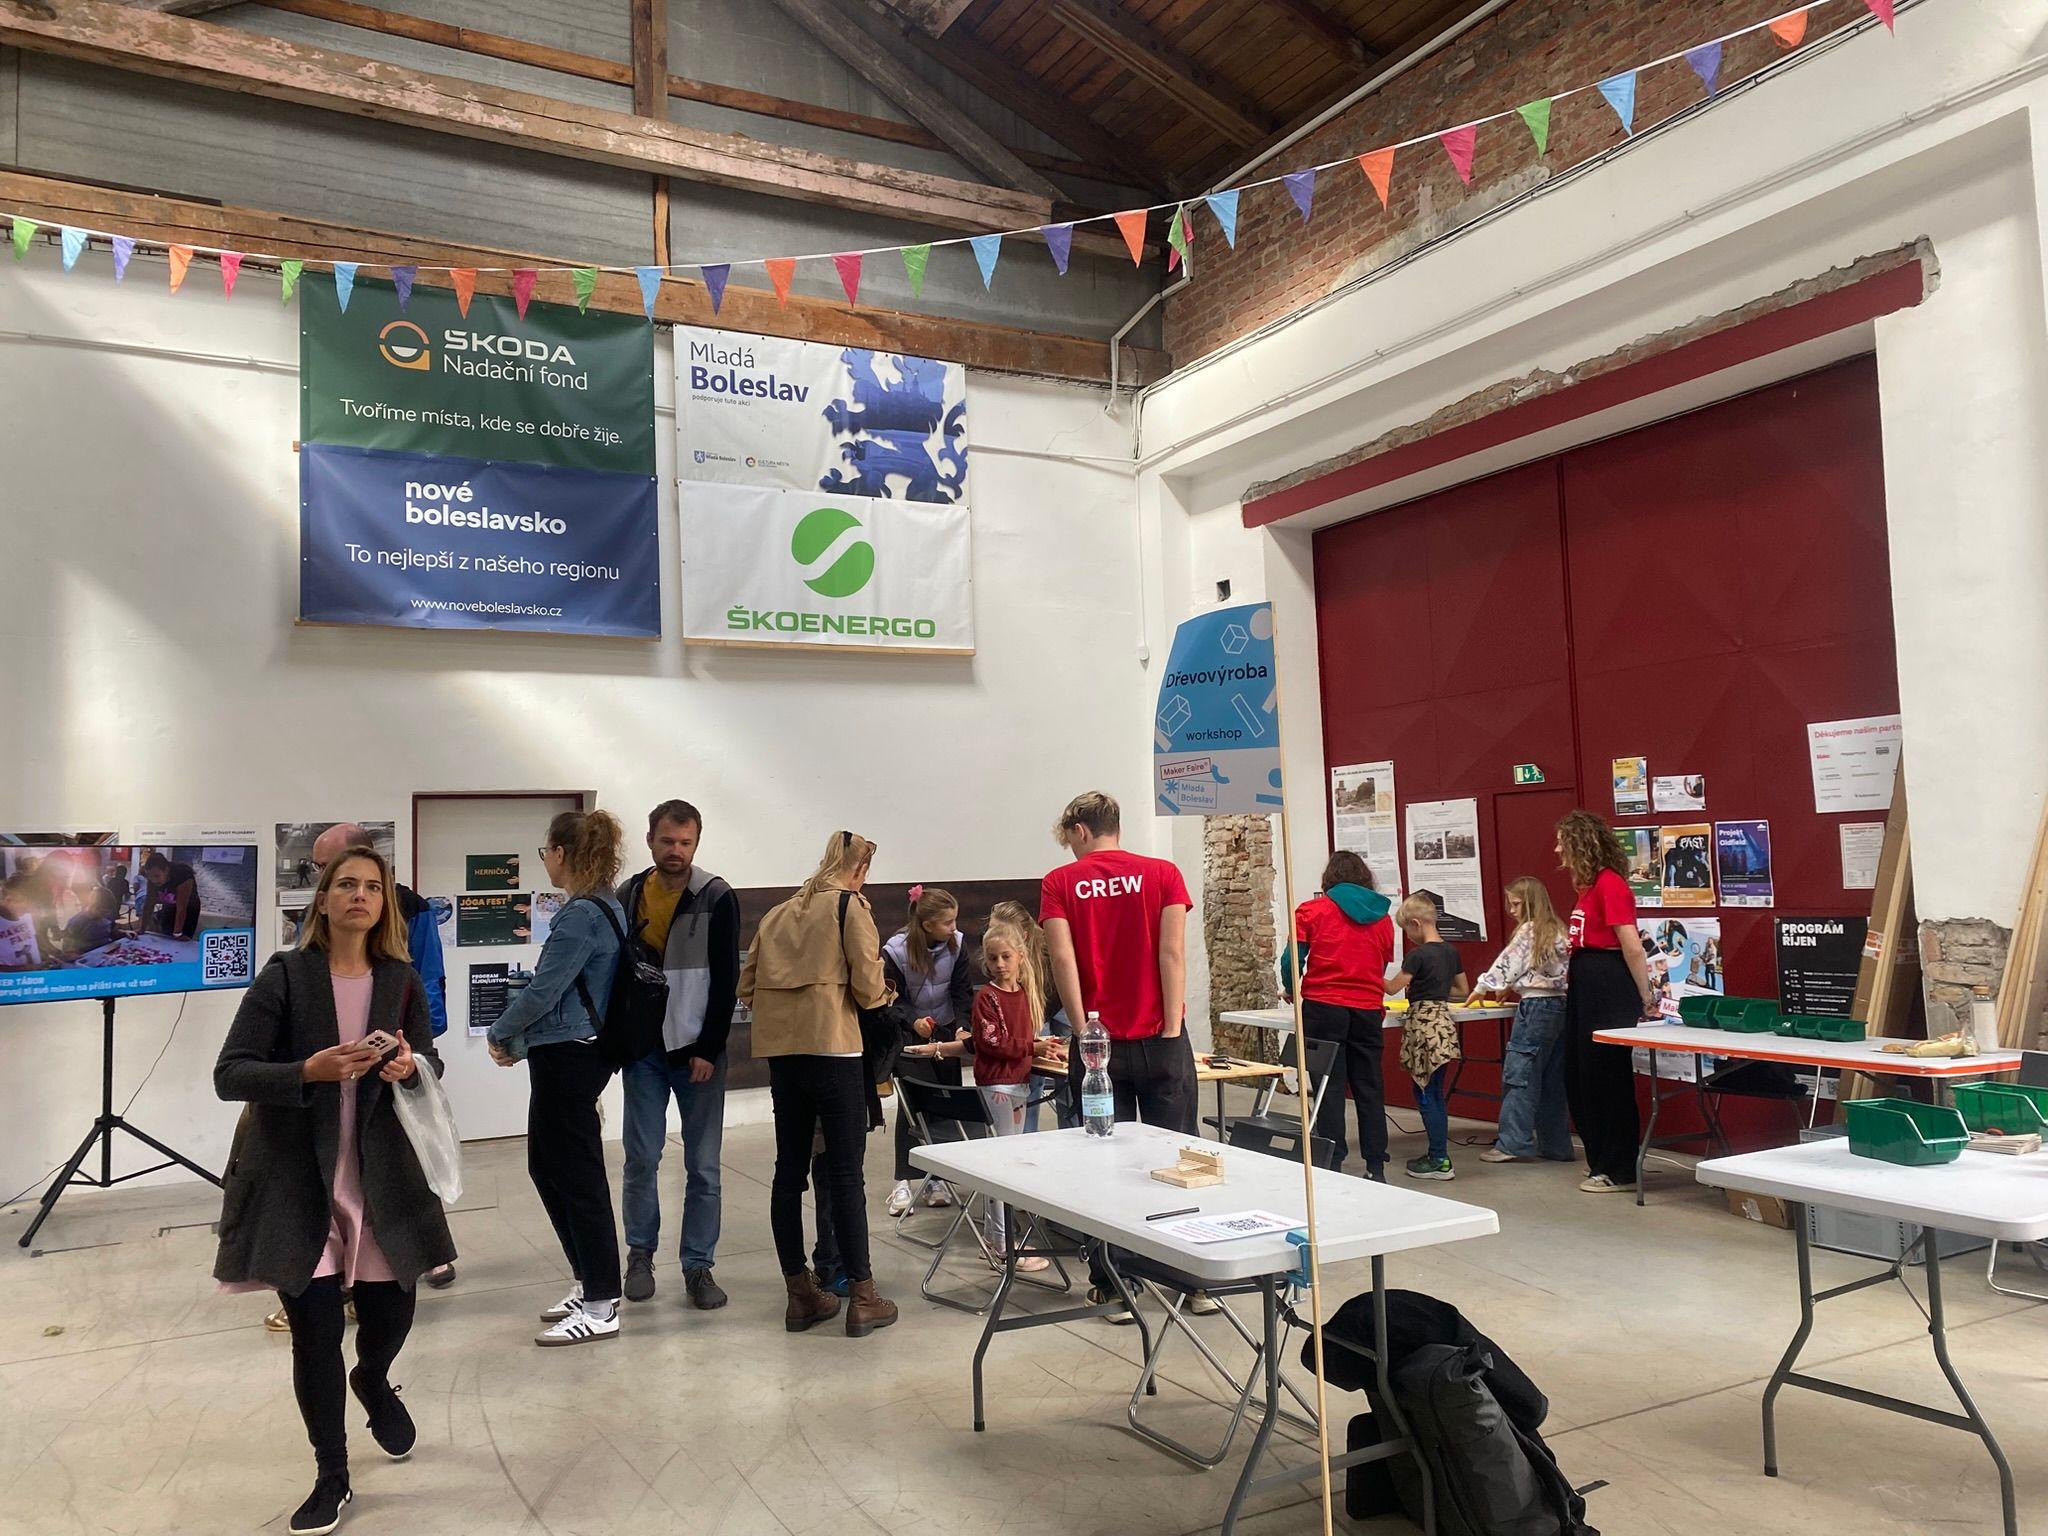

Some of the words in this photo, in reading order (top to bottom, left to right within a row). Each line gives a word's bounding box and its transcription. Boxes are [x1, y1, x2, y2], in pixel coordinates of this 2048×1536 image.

[690, 340, 755, 369] Mladá
[443, 353, 534, 382] Nadační
[539, 366, 588, 390] fond
[691, 365, 809, 403] Boleslav
[692, 394, 724, 404] podporuje
[339, 398, 417, 422] Tvoříme
[421, 409, 475, 431] místa,
[480, 413, 512, 432] kde
[516, 422, 535, 434] se
[539, 420, 590, 440] dobře
[594, 427, 623, 446] žije.
[405, 480, 473, 502] nové
[405, 501, 567, 535] boleslavsko
[345, 543, 371, 563] To
[377, 548, 454, 571] nejlepší
[458, 555, 469, 570] z
[474, 553, 544, 575] našeho
[549, 560, 620, 581] regionu
[410, 598, 563, 617] www.noveboleslavsko.cz
[726, 604, 936, 639] ŠKOENERGO
[1165, 663, 1268, 687] Dřevovýroba
[1185, 728, 1242, 741] workshop
[1814, 729, 1853, 739] Děkujeme
[1854, 725, 1878, 734] našim
[1163, 767, 1185, 775] Maker
[1181, 783, 1205, 792] Mladá
[1181, 793, 1214, 803] Boleslav
[1719, 829, 1743, 837] Projekt
[1719, 838, 1746, 846] Oldfield
[474, 867, 510, 876] HERNIČKA
[1075, 875, 1142, 899] CREW
[459, 897, 485, 906] JÓGA
[486, 897, 507, 906] FEST
[1781, 923, 1844, 934] PROGRAM
[1782, 933, 1817, 946] ŘÍJEN
[16, 975, 45, 985] TÁBOR
